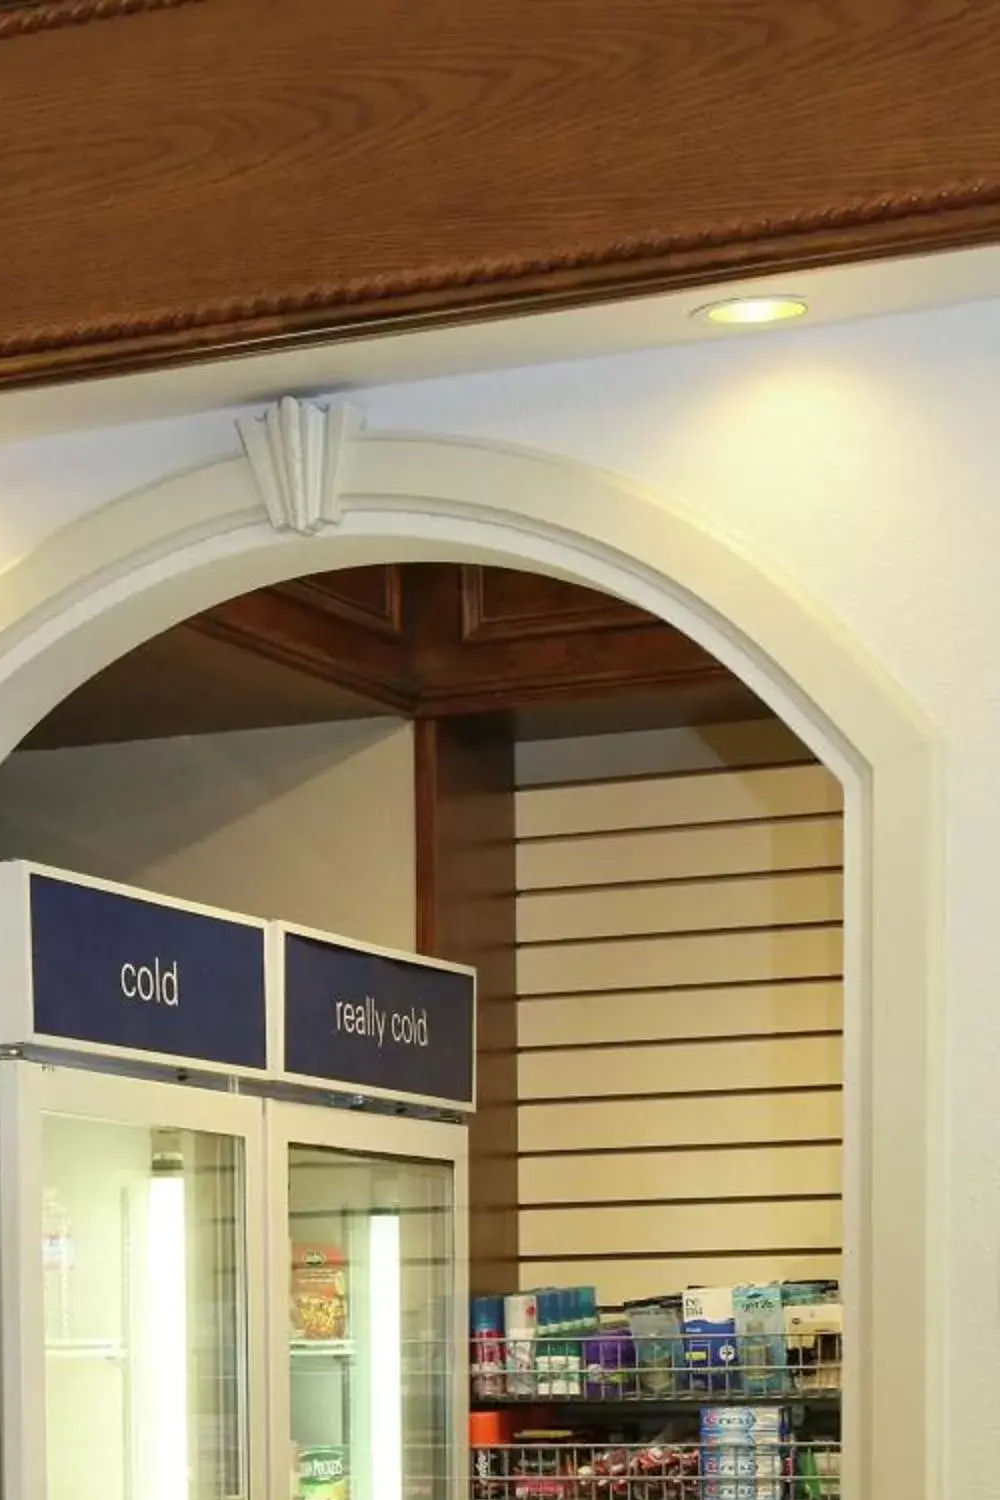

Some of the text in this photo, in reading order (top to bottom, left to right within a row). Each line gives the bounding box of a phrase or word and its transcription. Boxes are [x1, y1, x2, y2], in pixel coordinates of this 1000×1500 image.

[120, 956, 179, 1006] cold
[335, 995, 429, 1048] really cold
